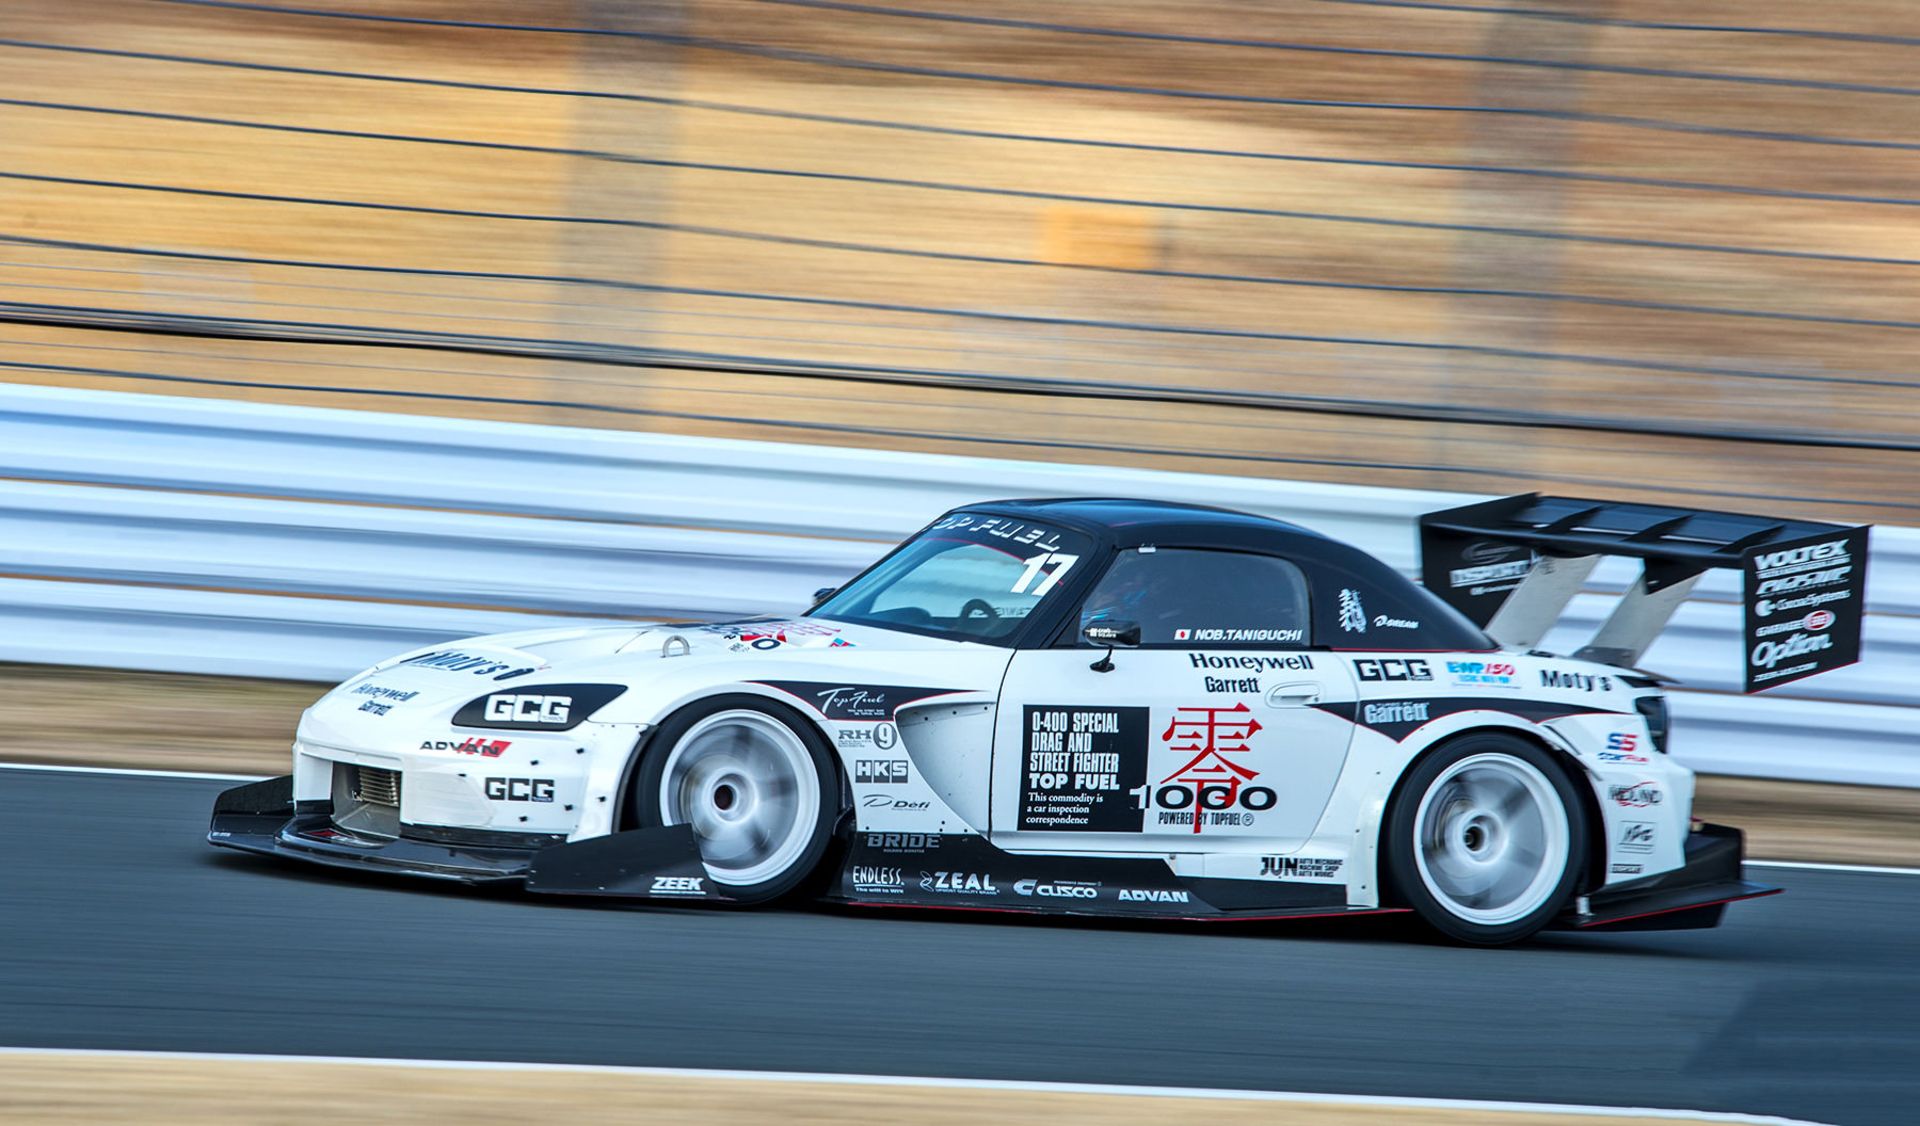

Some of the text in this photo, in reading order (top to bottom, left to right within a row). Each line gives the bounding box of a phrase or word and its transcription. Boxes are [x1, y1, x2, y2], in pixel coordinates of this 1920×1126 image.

[969, 519, 1060, 552] FUEL
[1754, 538, 1850, 571] VOLTEX
[1010, 552, 1080, 597] 17
[1194, 628, 1303, 641] NOB.TANIGUCHI
[1751, 633, 1834, 669] Option
[1188, 653, 1314, 673] Honeywell
[1353, 659, 1434, 681] GCG
[351, 682, 420, 702] Honeywell
[1204, 675, 1262, 693] Garrett
[484, 694, 573, 723] GCG
[1364, 701, 1430, 724] Garrett
[1032, 711, 1119, 733] 0-400 SPECIAL
[419, 740, 504, 756] ADVAN
[1031, 732, 1092, 752] DRAG AND
[855, 760, 908, 782] HKS
[1029, 752, 1119, 773] STREET FIGHTER
[1160, 702, 1263, 834] 零
[484, 777, 555, 802] GCG
[1029, 773, 1120, 790] TOP FUEL
[1028, 792, 1104, 804] This commodity is
[1048, 804, 1090, 815] inspection
[1158, 812, 1240, 826] POWERED BY TOPFUEL
[1026, 815, 1089, 826] correspondence
[867, 833, 940, 848] BRIDE
[1260, 857, 1299, 876] JUN
[651, 876, 704, 891] ZEEK
[935, 871, 996, 891] ZEAL
[1037, 885, 1098, 898] CUSCO
[1118, 889, 1189, 902] ADVAN
